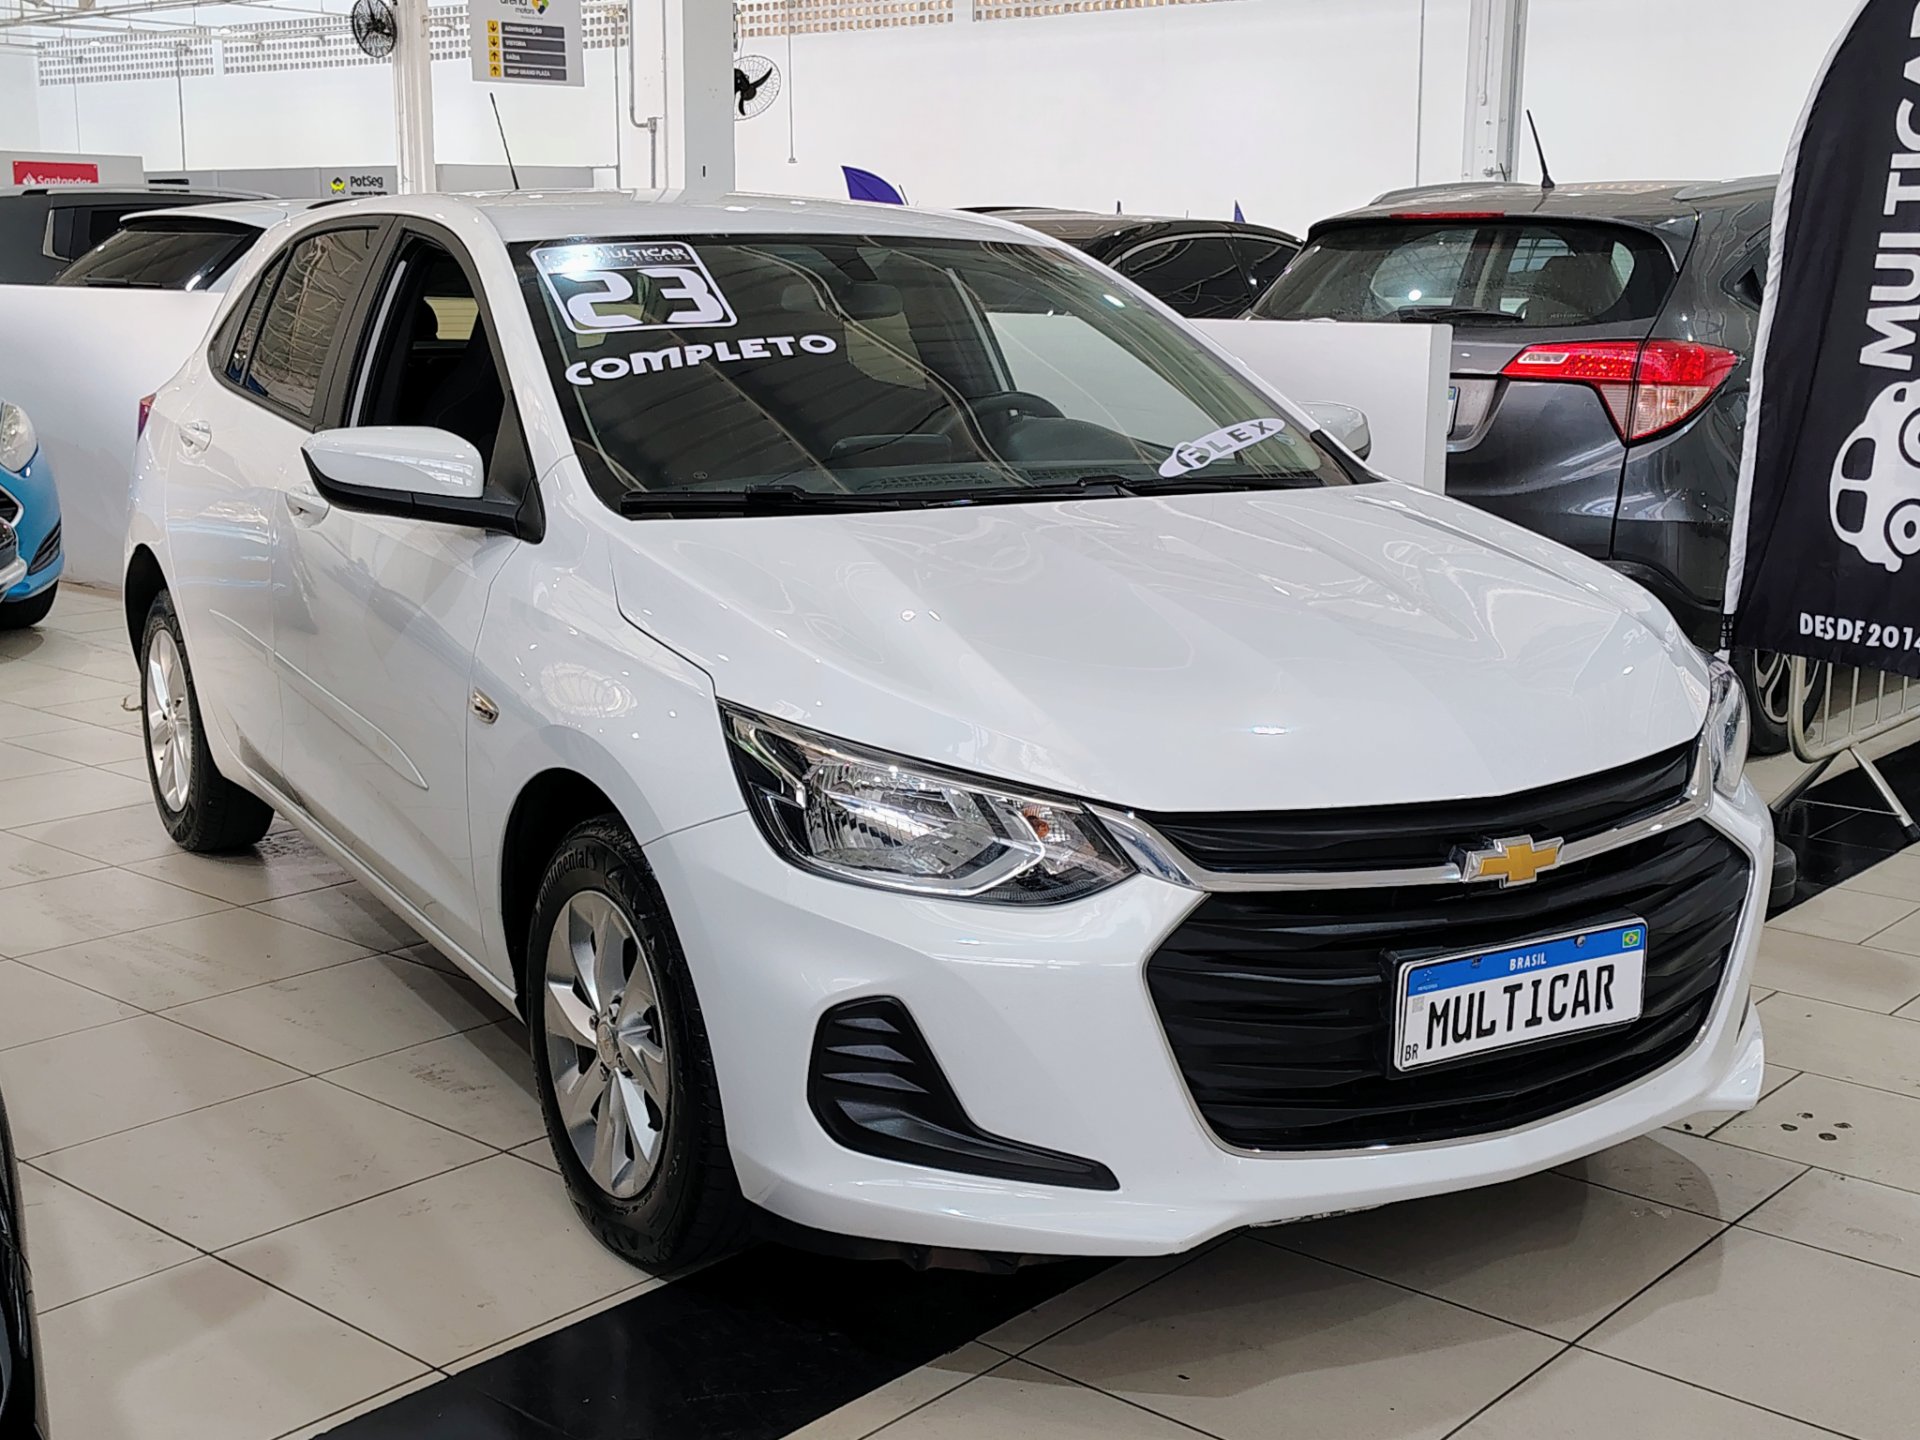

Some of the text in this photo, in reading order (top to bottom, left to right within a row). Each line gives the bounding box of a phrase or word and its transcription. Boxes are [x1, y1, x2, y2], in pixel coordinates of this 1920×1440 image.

[350, 175, 384, 188] PotSeg
[567, 268, 724, 327] 23
[565, 334, 837, 386] COMPLETO
[1178, 421, 1274, 470] FLEX
[1509, 952, 1547, 971] BRASIL
[1426, 964, 1615, 1049] MULTICAR
[1404, 1043, 1419, 1061] BR
